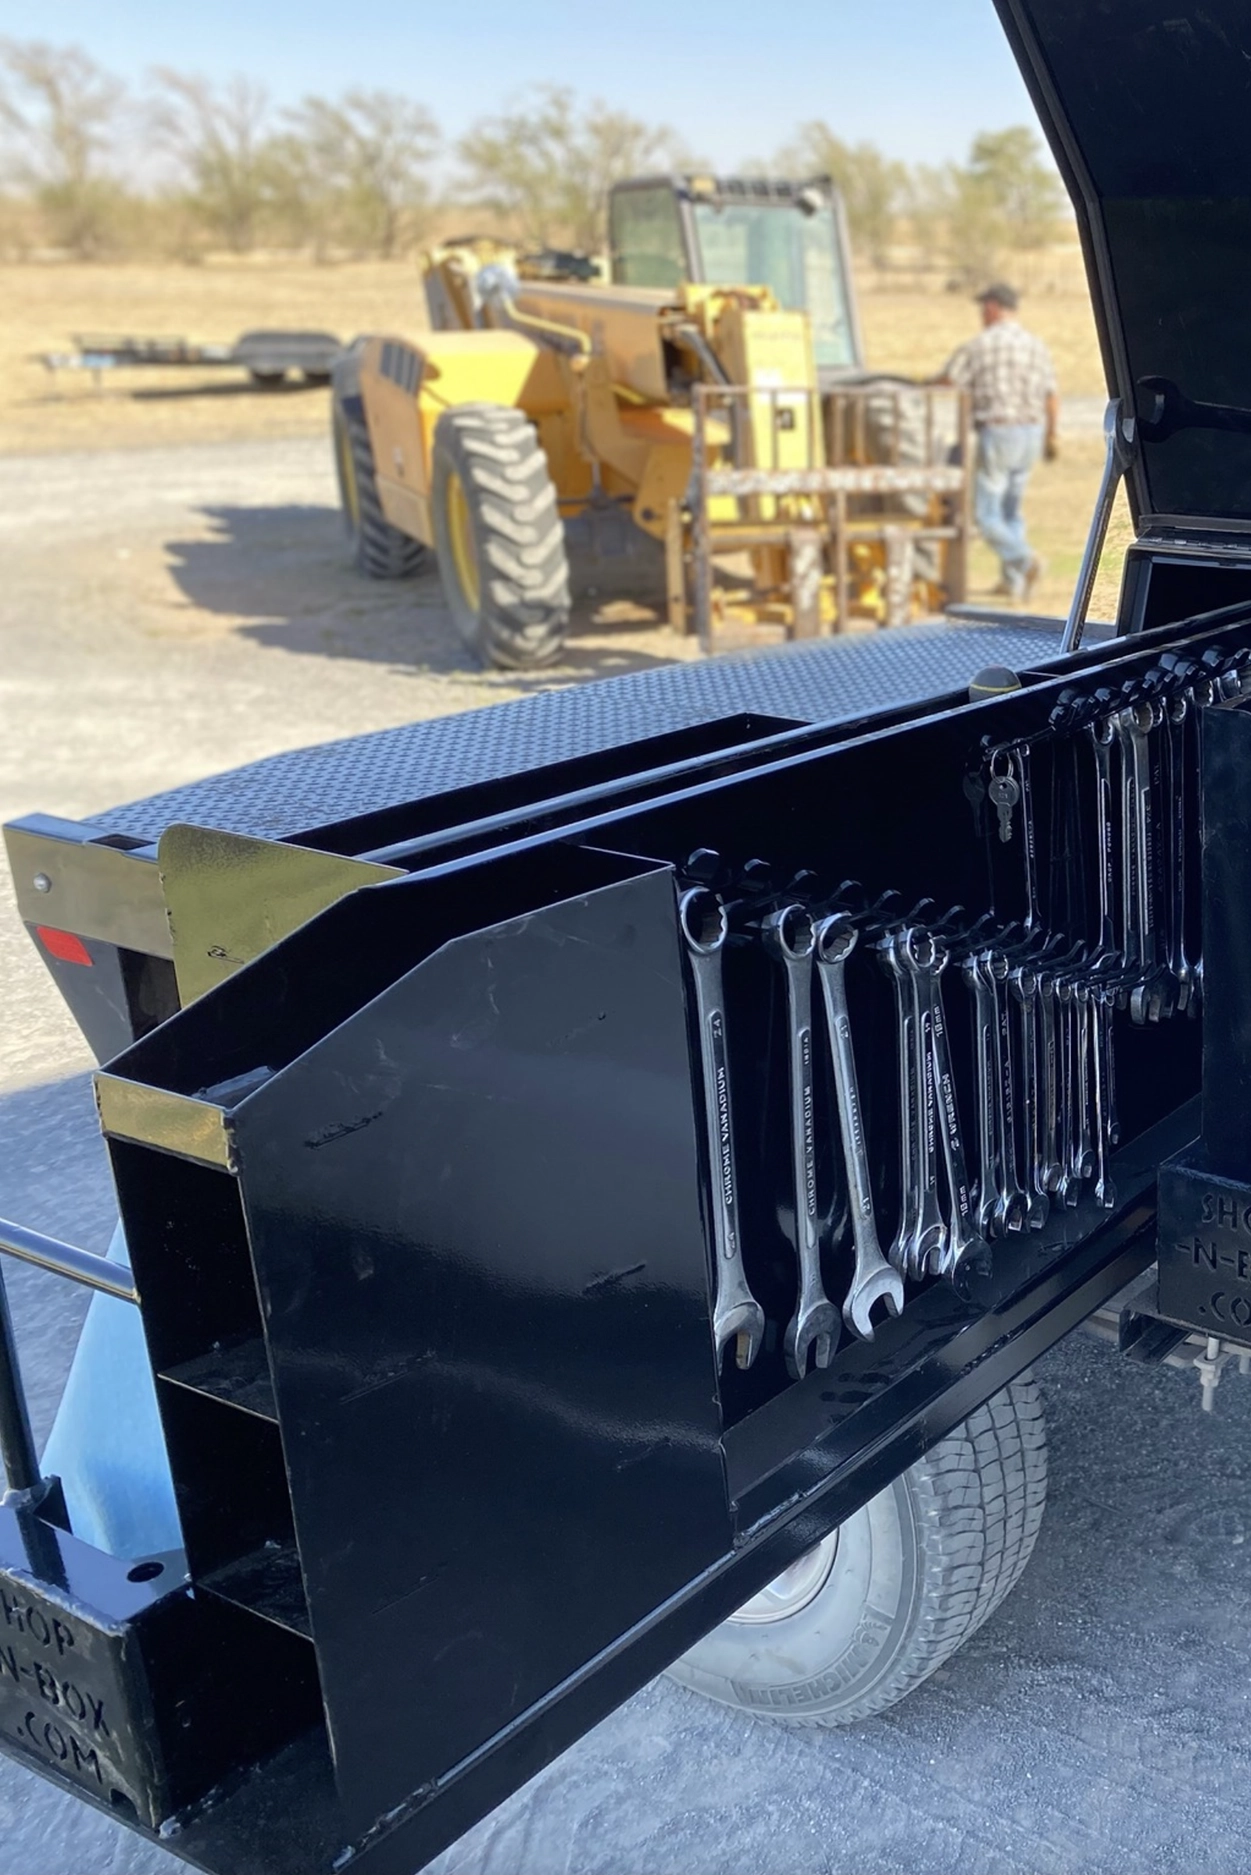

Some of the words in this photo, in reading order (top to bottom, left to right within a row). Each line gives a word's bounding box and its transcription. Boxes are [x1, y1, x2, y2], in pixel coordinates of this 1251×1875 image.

[713, 1018, 722, 1038] 24
[717, 1067, 729, 1142] VANADIUM
[803, 1085, 814, 1153] VANADIUM
[941, 1073, 957, 1134] WRENCH
[722, 1144, 733, 1205] CHROME
[807, 1157, 816, 1216] CHROME
[0, 1588, 74, 1655] HOP
[749, 1645, 869, 1706] MICHELIN
[17, 1711, 103, 1784] .COM
